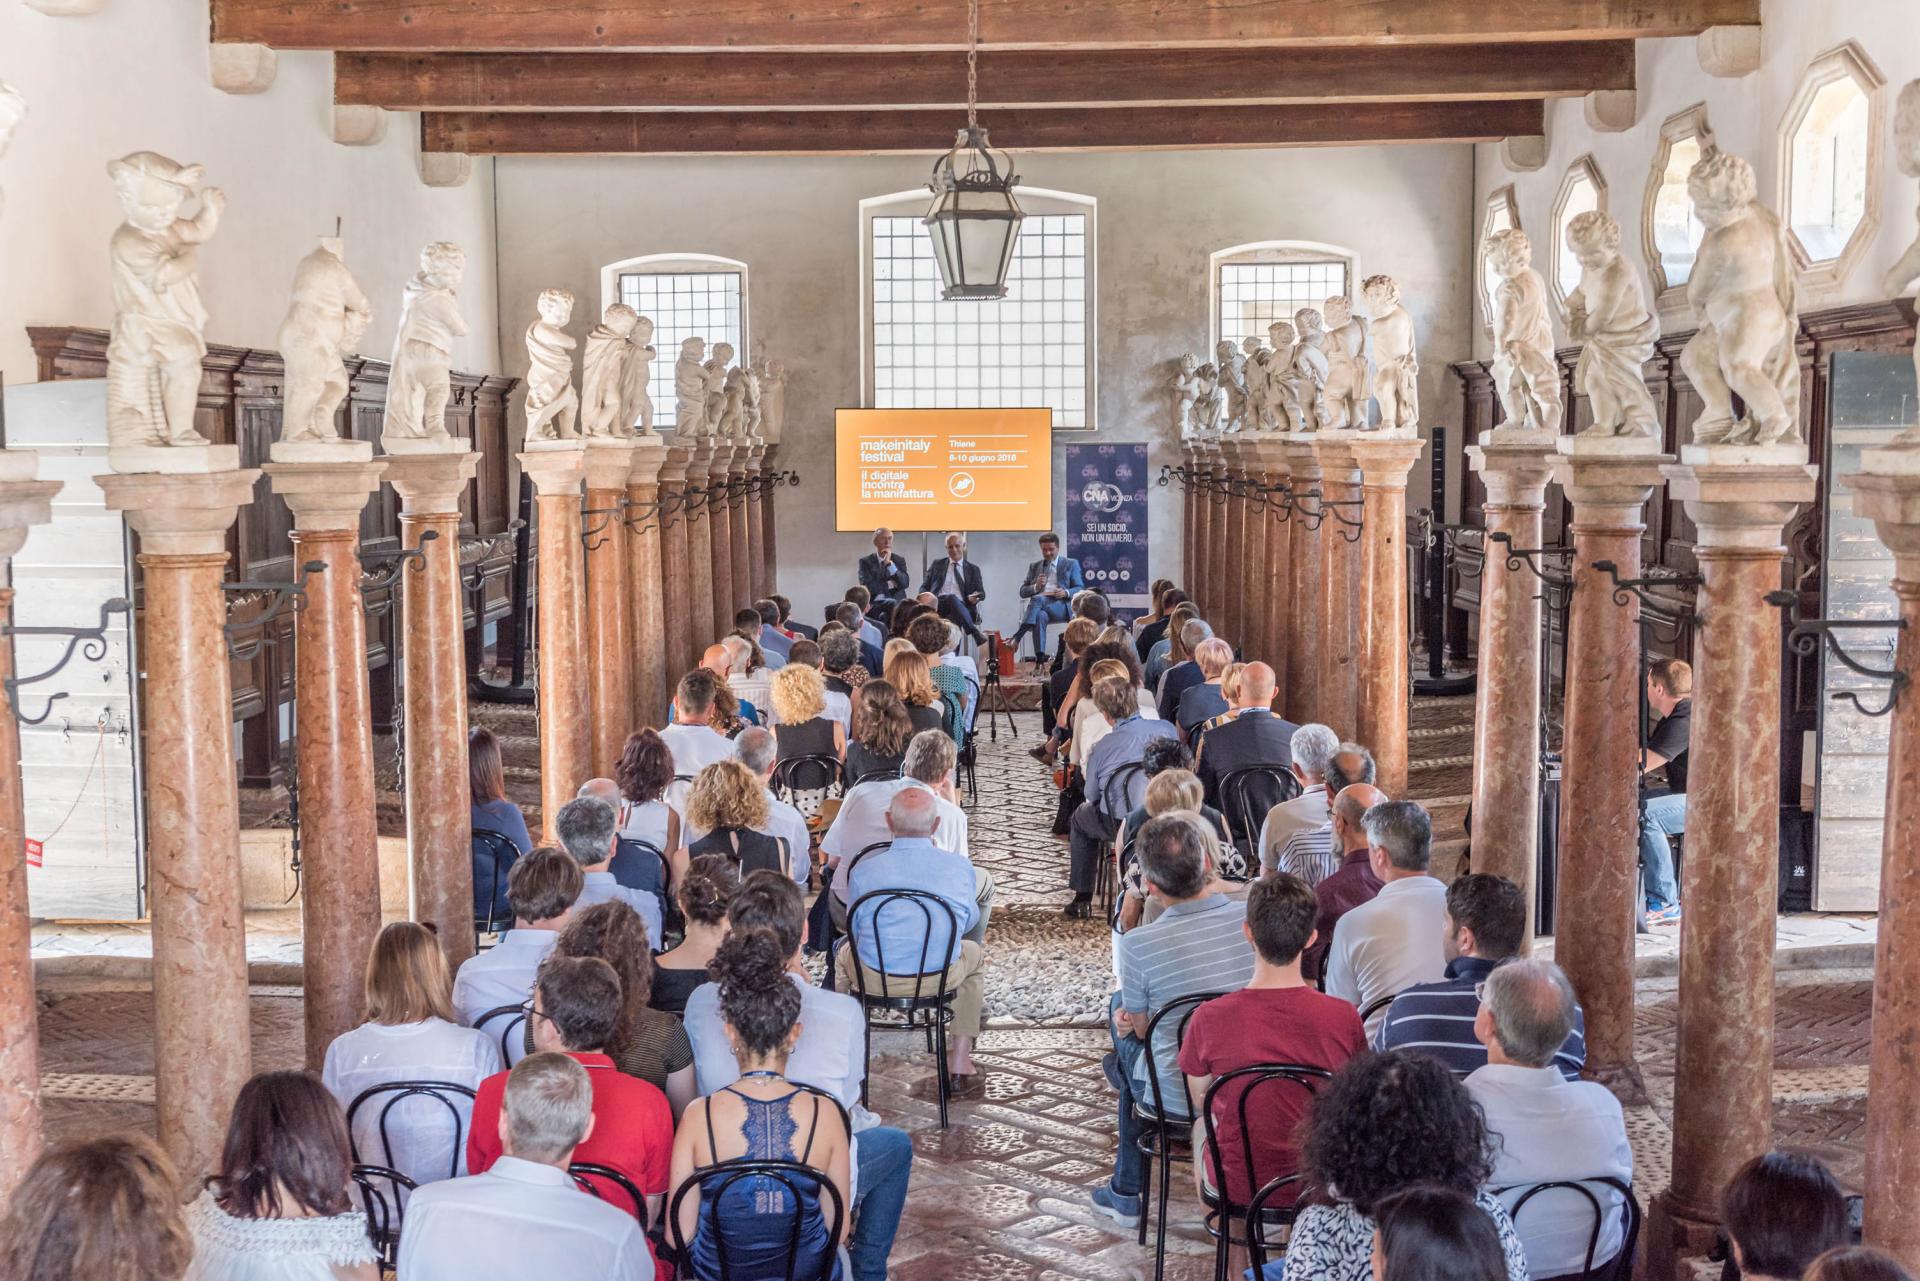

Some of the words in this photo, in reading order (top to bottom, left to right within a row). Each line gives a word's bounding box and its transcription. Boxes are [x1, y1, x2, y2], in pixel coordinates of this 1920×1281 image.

[861, 440, 931, 453] makeinitaly
[949, 440, 976, 448] Thiene
[861, 450, 904, 462] festival
[969, 454, 996, 464] giugno
[862, 471, 867, 480] il
[870, 471, 909, 482] digitale
[1082, 468, 1099, 477] CNA
[1115, 468, 1133, 477] CNA
[862, 481, 905, 490] incontra
[862, 489, 871, 499] la
[873, 489, 935, 499] manifattura
[1083, 490, 1109, 502] CNA
[1086, 523, 1096, 532] SEI
[1097, 523, 1107, 532] UN
[1081, 533, 1095, 543] NON
[1096, 533, 1105, 543] UN
